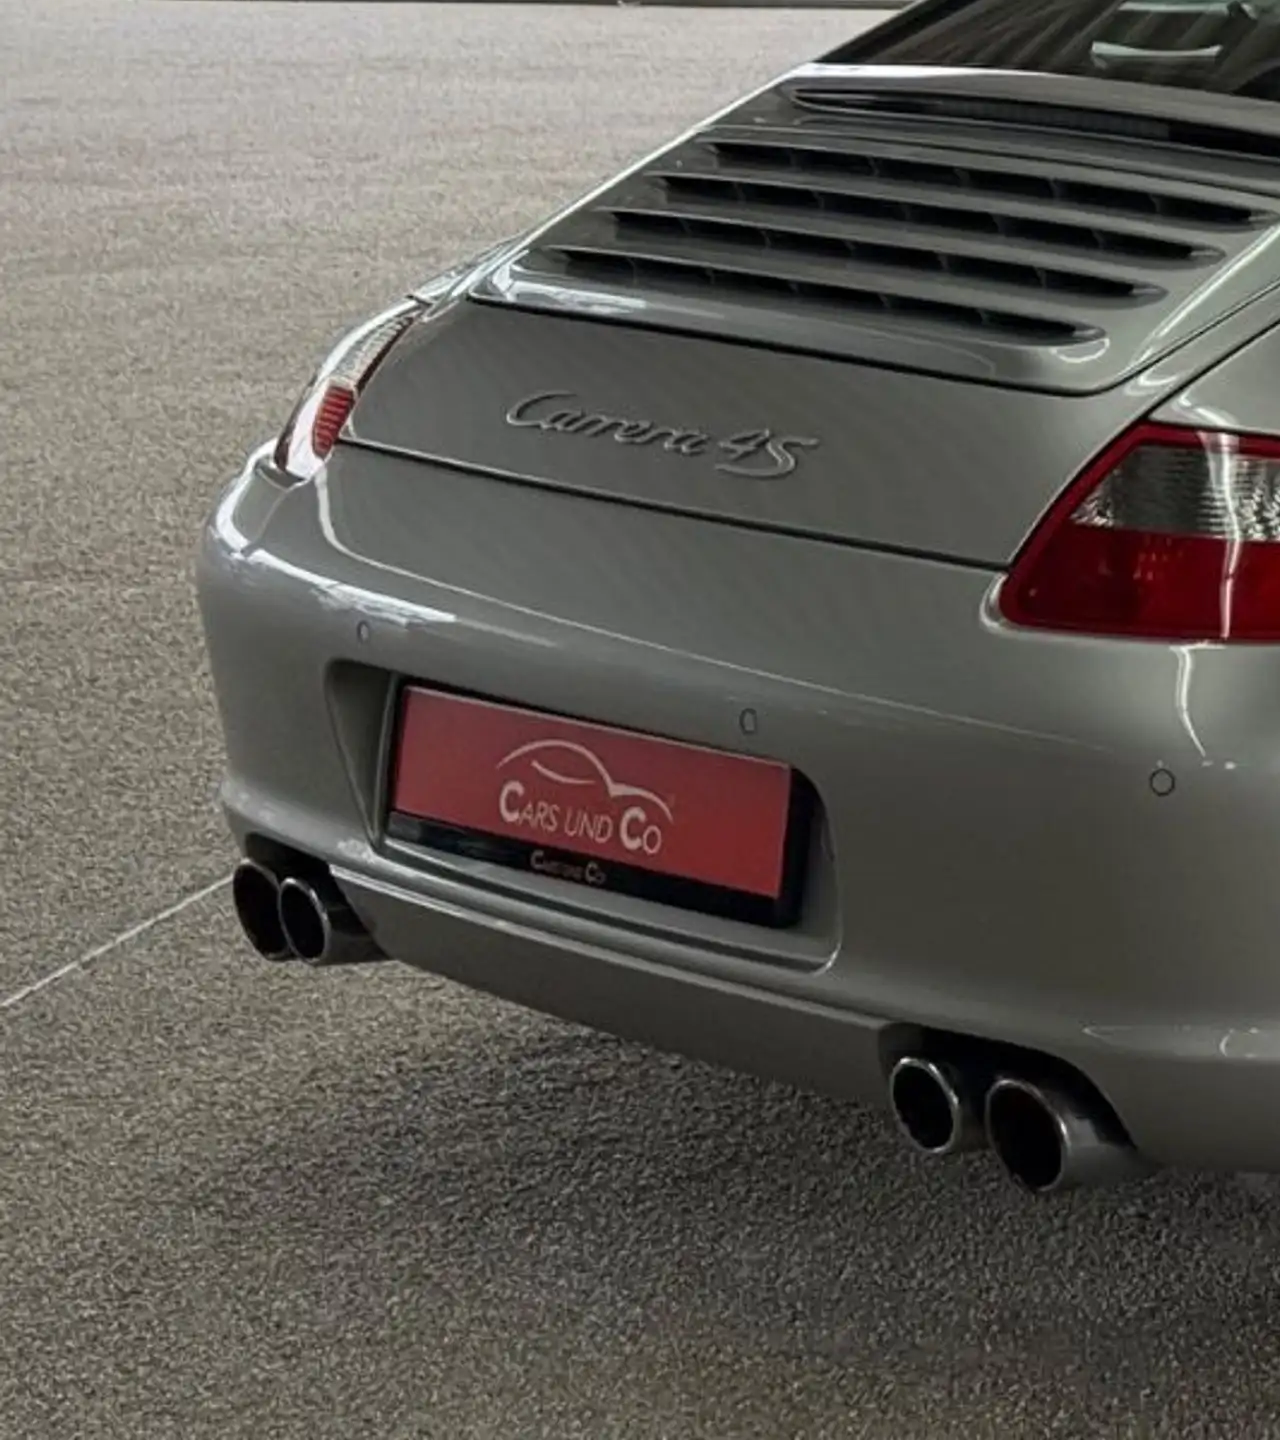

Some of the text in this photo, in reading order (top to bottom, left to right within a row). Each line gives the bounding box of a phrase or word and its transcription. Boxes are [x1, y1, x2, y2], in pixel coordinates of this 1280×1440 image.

[505, 389, 821, 479] Carrera 4S
[563, 811, 612, 844] UND
